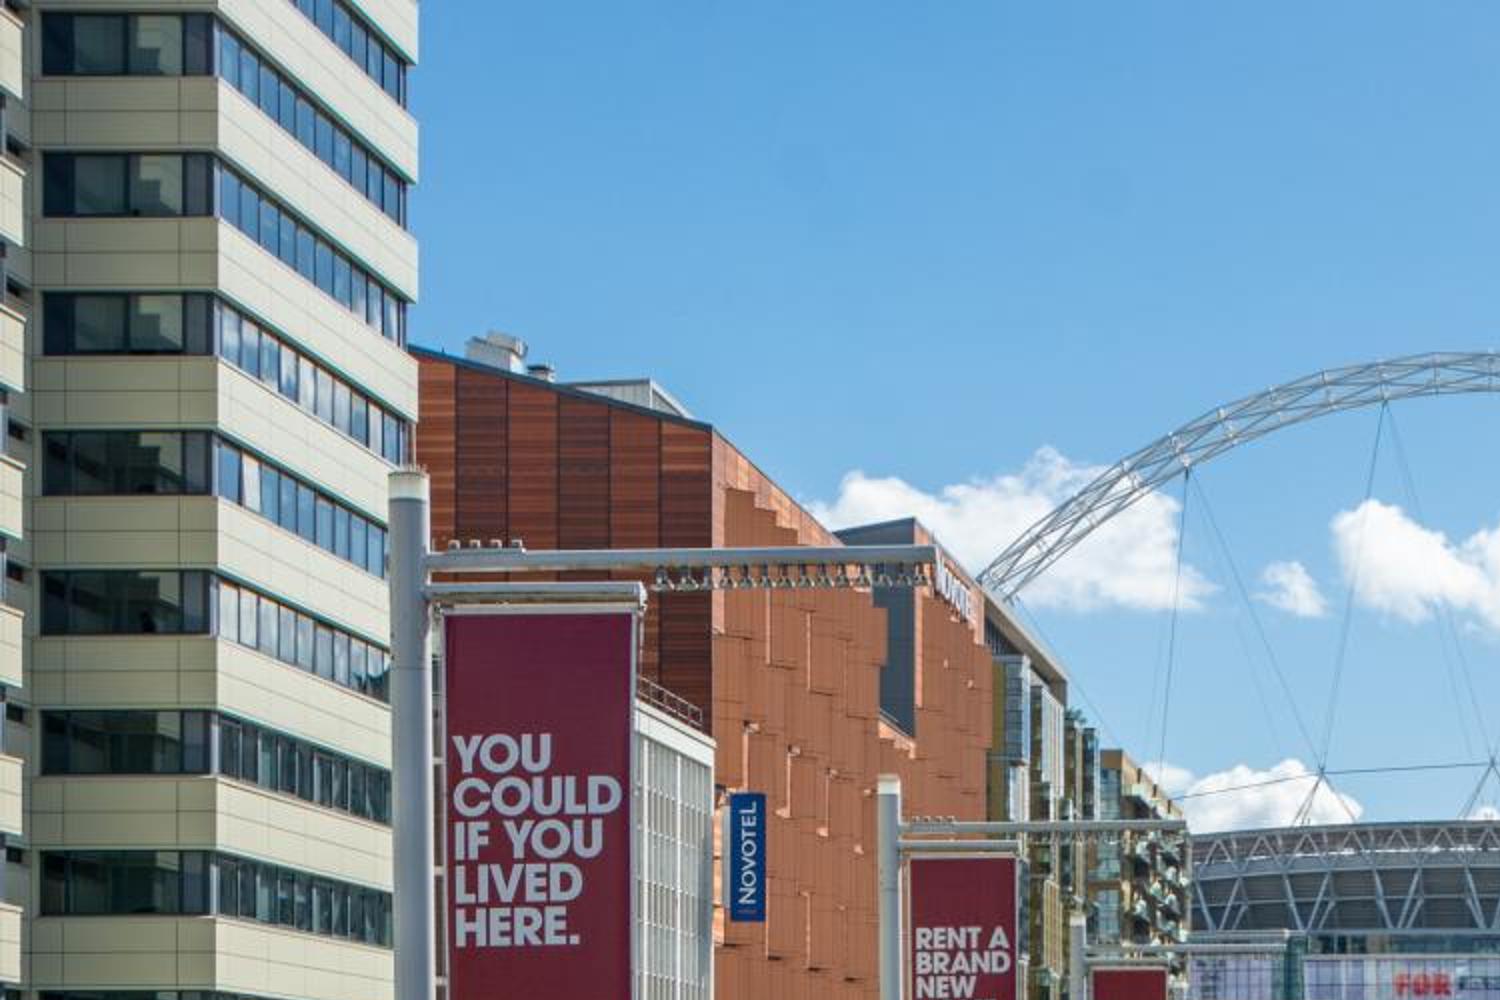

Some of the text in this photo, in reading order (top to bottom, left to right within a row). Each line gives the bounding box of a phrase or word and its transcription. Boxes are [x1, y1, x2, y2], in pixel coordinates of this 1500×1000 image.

[452, 734, 552, 774] YOU
[452, 775, 622, 816] COULD
[454, 819, 604, 861] IF YOU
[738, 800, 758, 905] NOVOTEL
[455, 863, 584, 905] LIVED
[455, 906, 581, 948] HERE.
[916, 926, 1010, 950] RENT A
[916, 951, 1011, 974] BRAND
[916, 976, 976, 998] NEW
